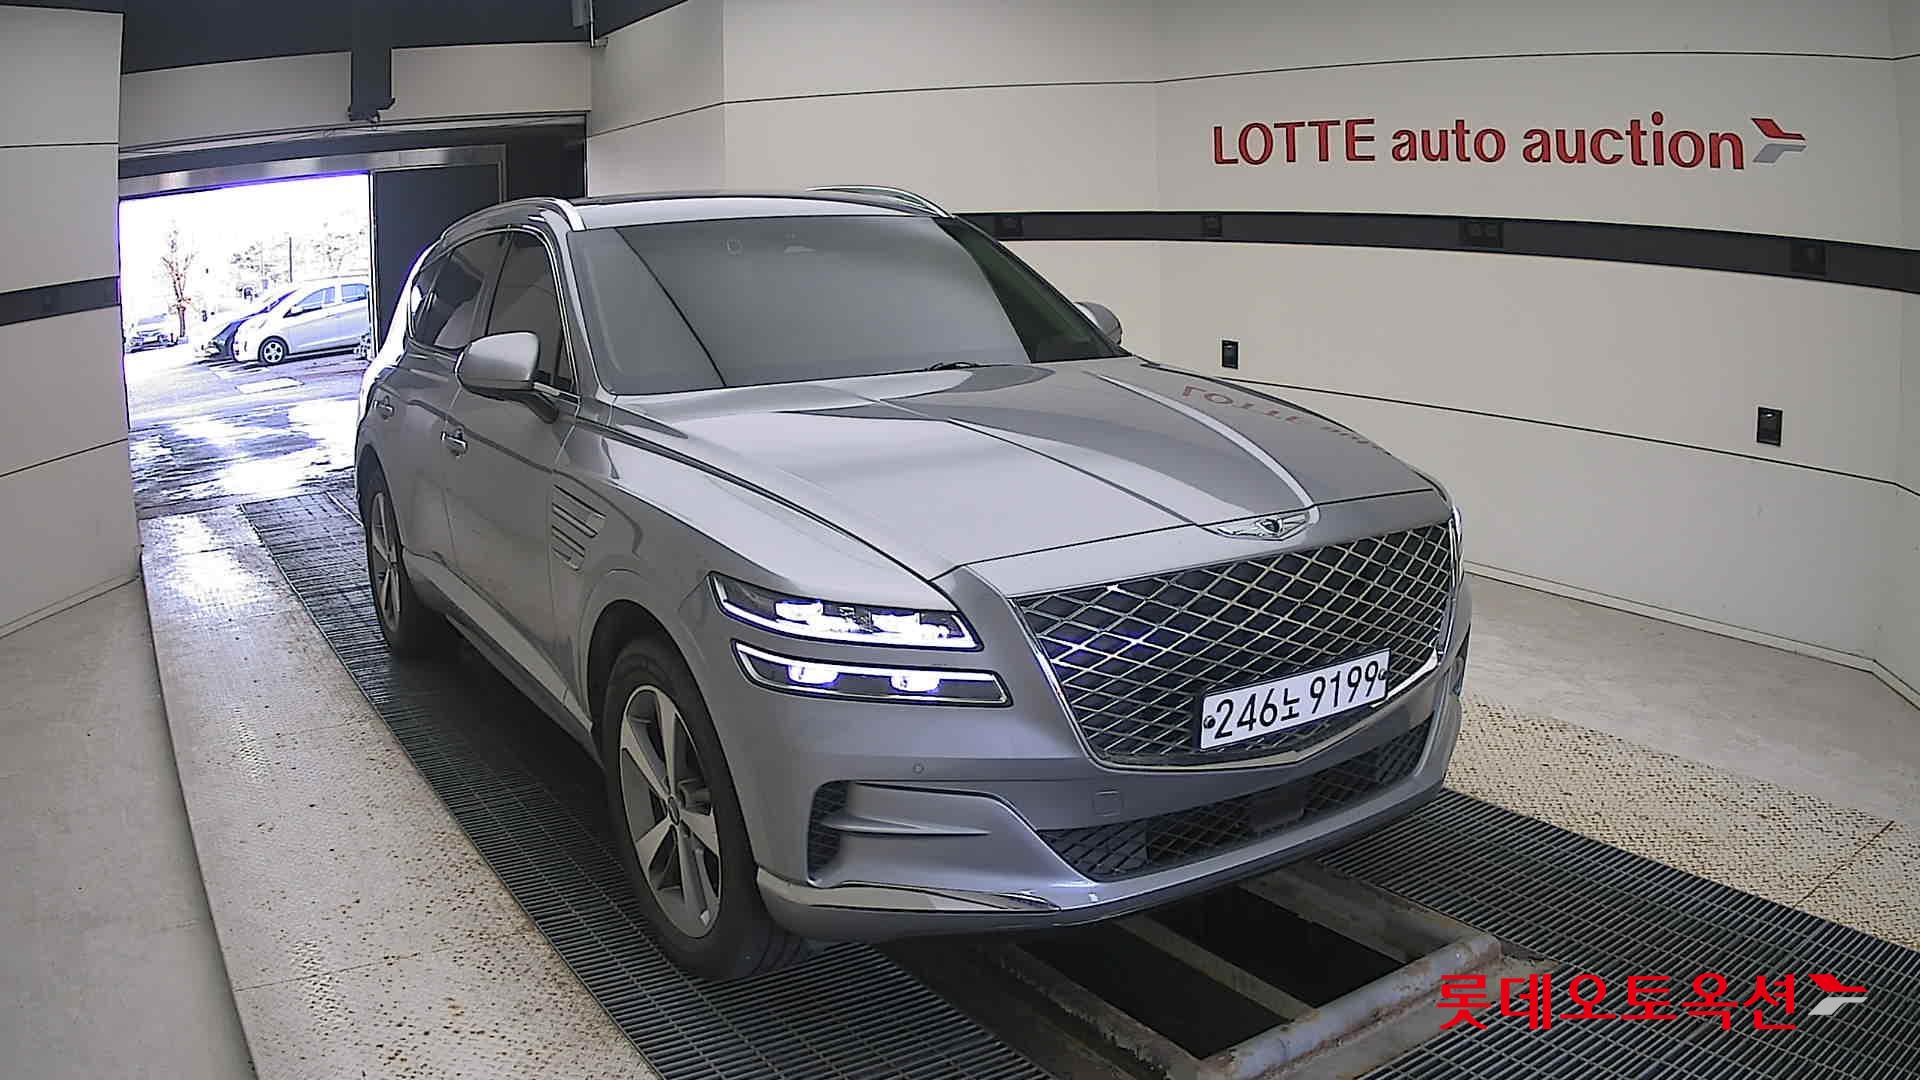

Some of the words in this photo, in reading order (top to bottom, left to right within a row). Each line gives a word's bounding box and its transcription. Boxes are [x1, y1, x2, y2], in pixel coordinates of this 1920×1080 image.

[1212, 117, 1376, 165] LOTTE
[1392, 119, 1507, 163] auto
[1523, 111, 1745, 170] auction
[1214, 688, 1300, 739] 246노
[1310, 660, 1379, 714] 9199
